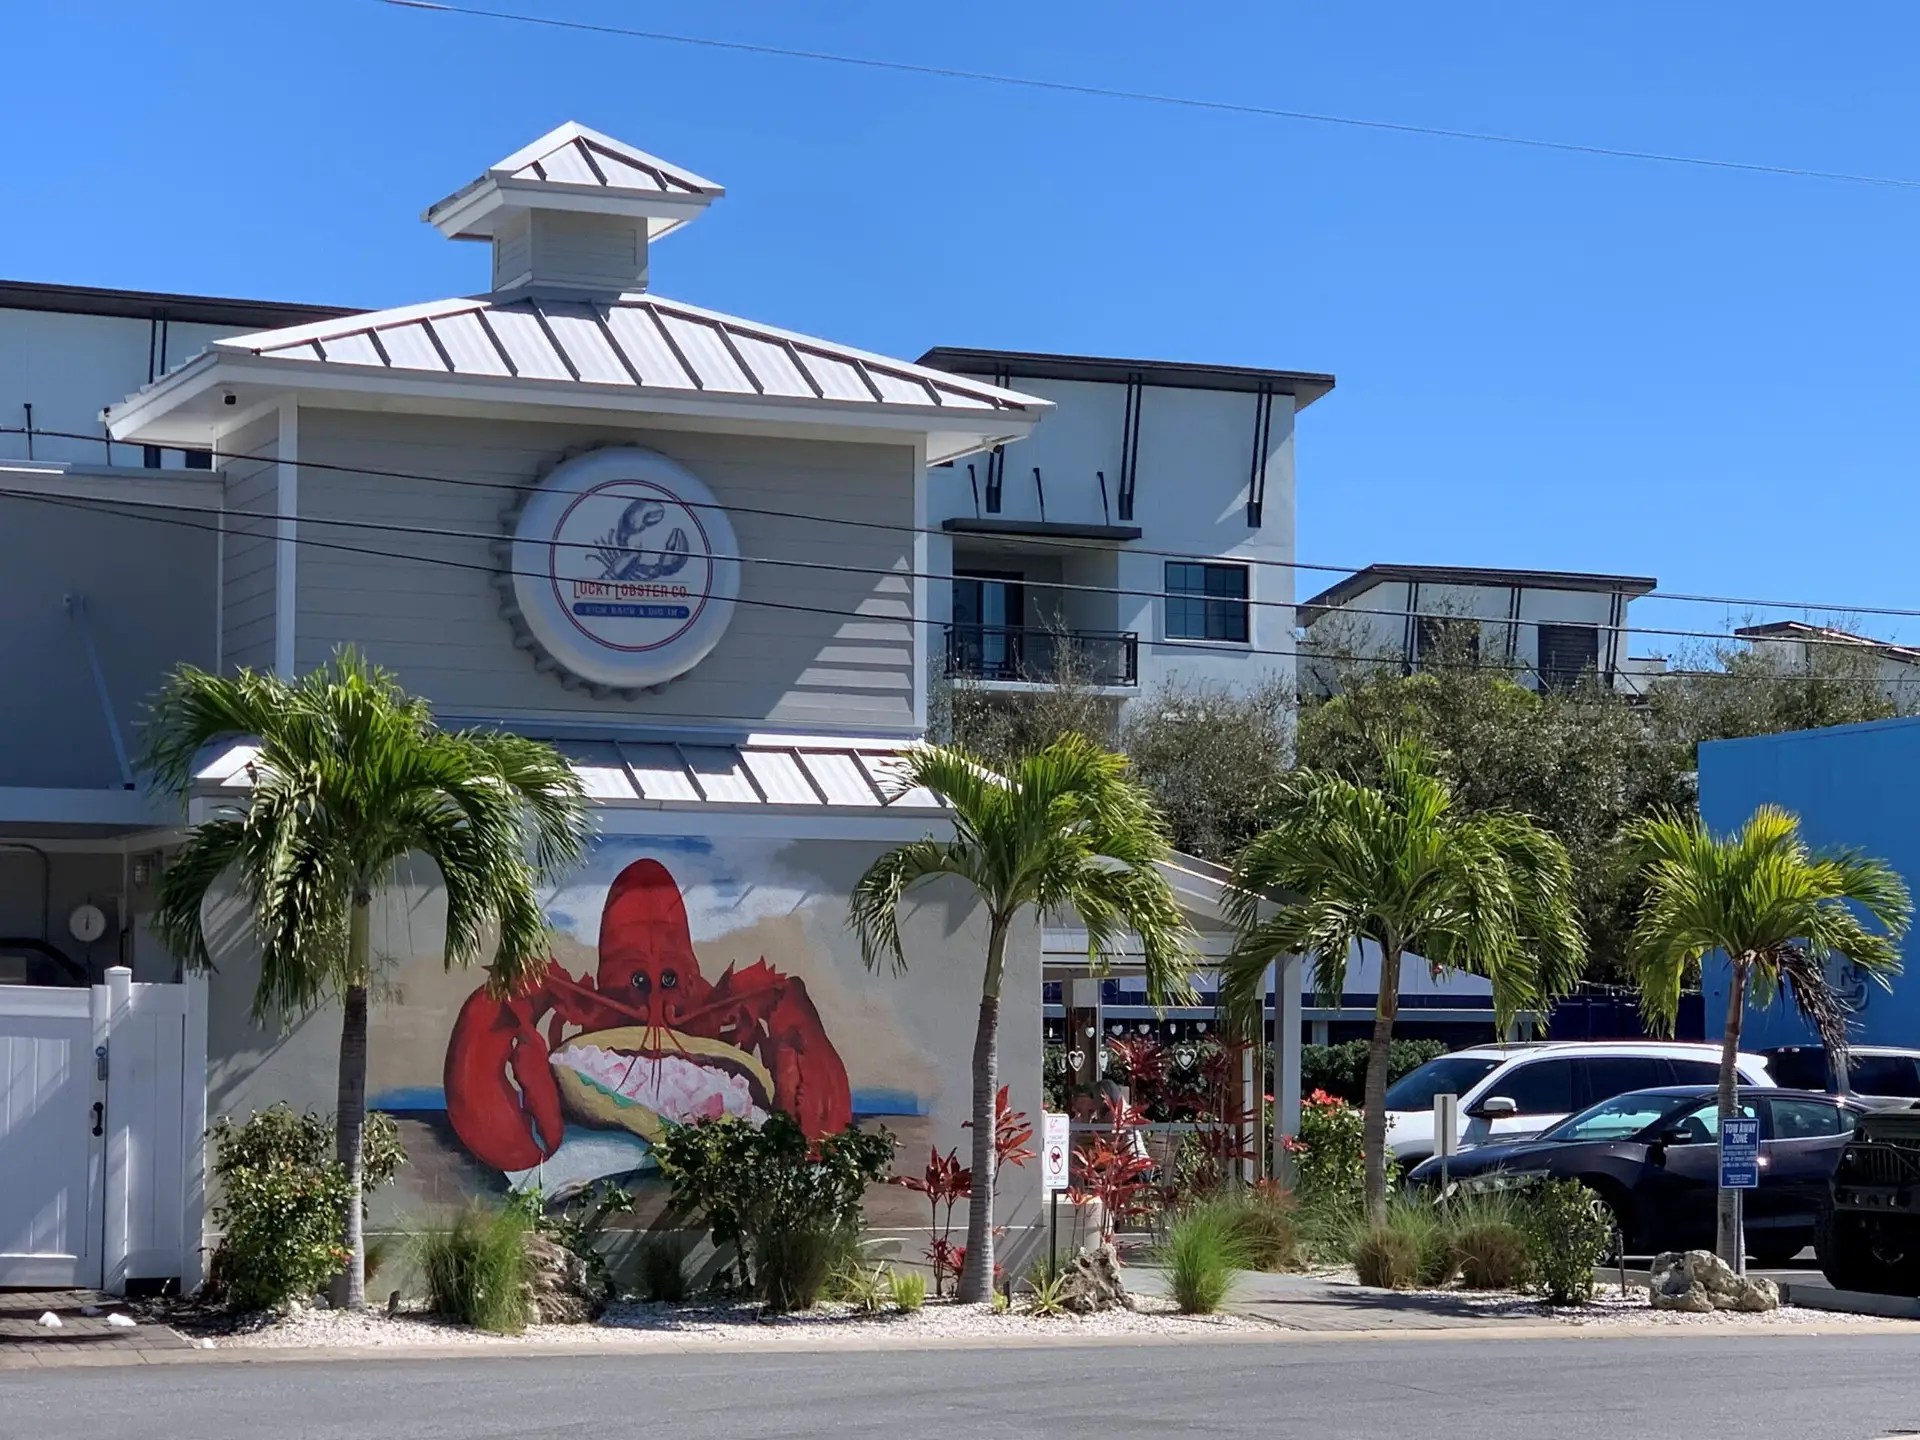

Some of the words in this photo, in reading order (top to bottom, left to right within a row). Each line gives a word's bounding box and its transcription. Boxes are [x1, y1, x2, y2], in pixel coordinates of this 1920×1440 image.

[574, 581, 609, 599] LUCKY
[615, 583, 668, 600] LOBSTER
[1725, 1123, 1739, 1134] TOW
[1739, 1122, 1756, 1133] AWAY
[1732, 1133, 1748, 1144] ZONE
